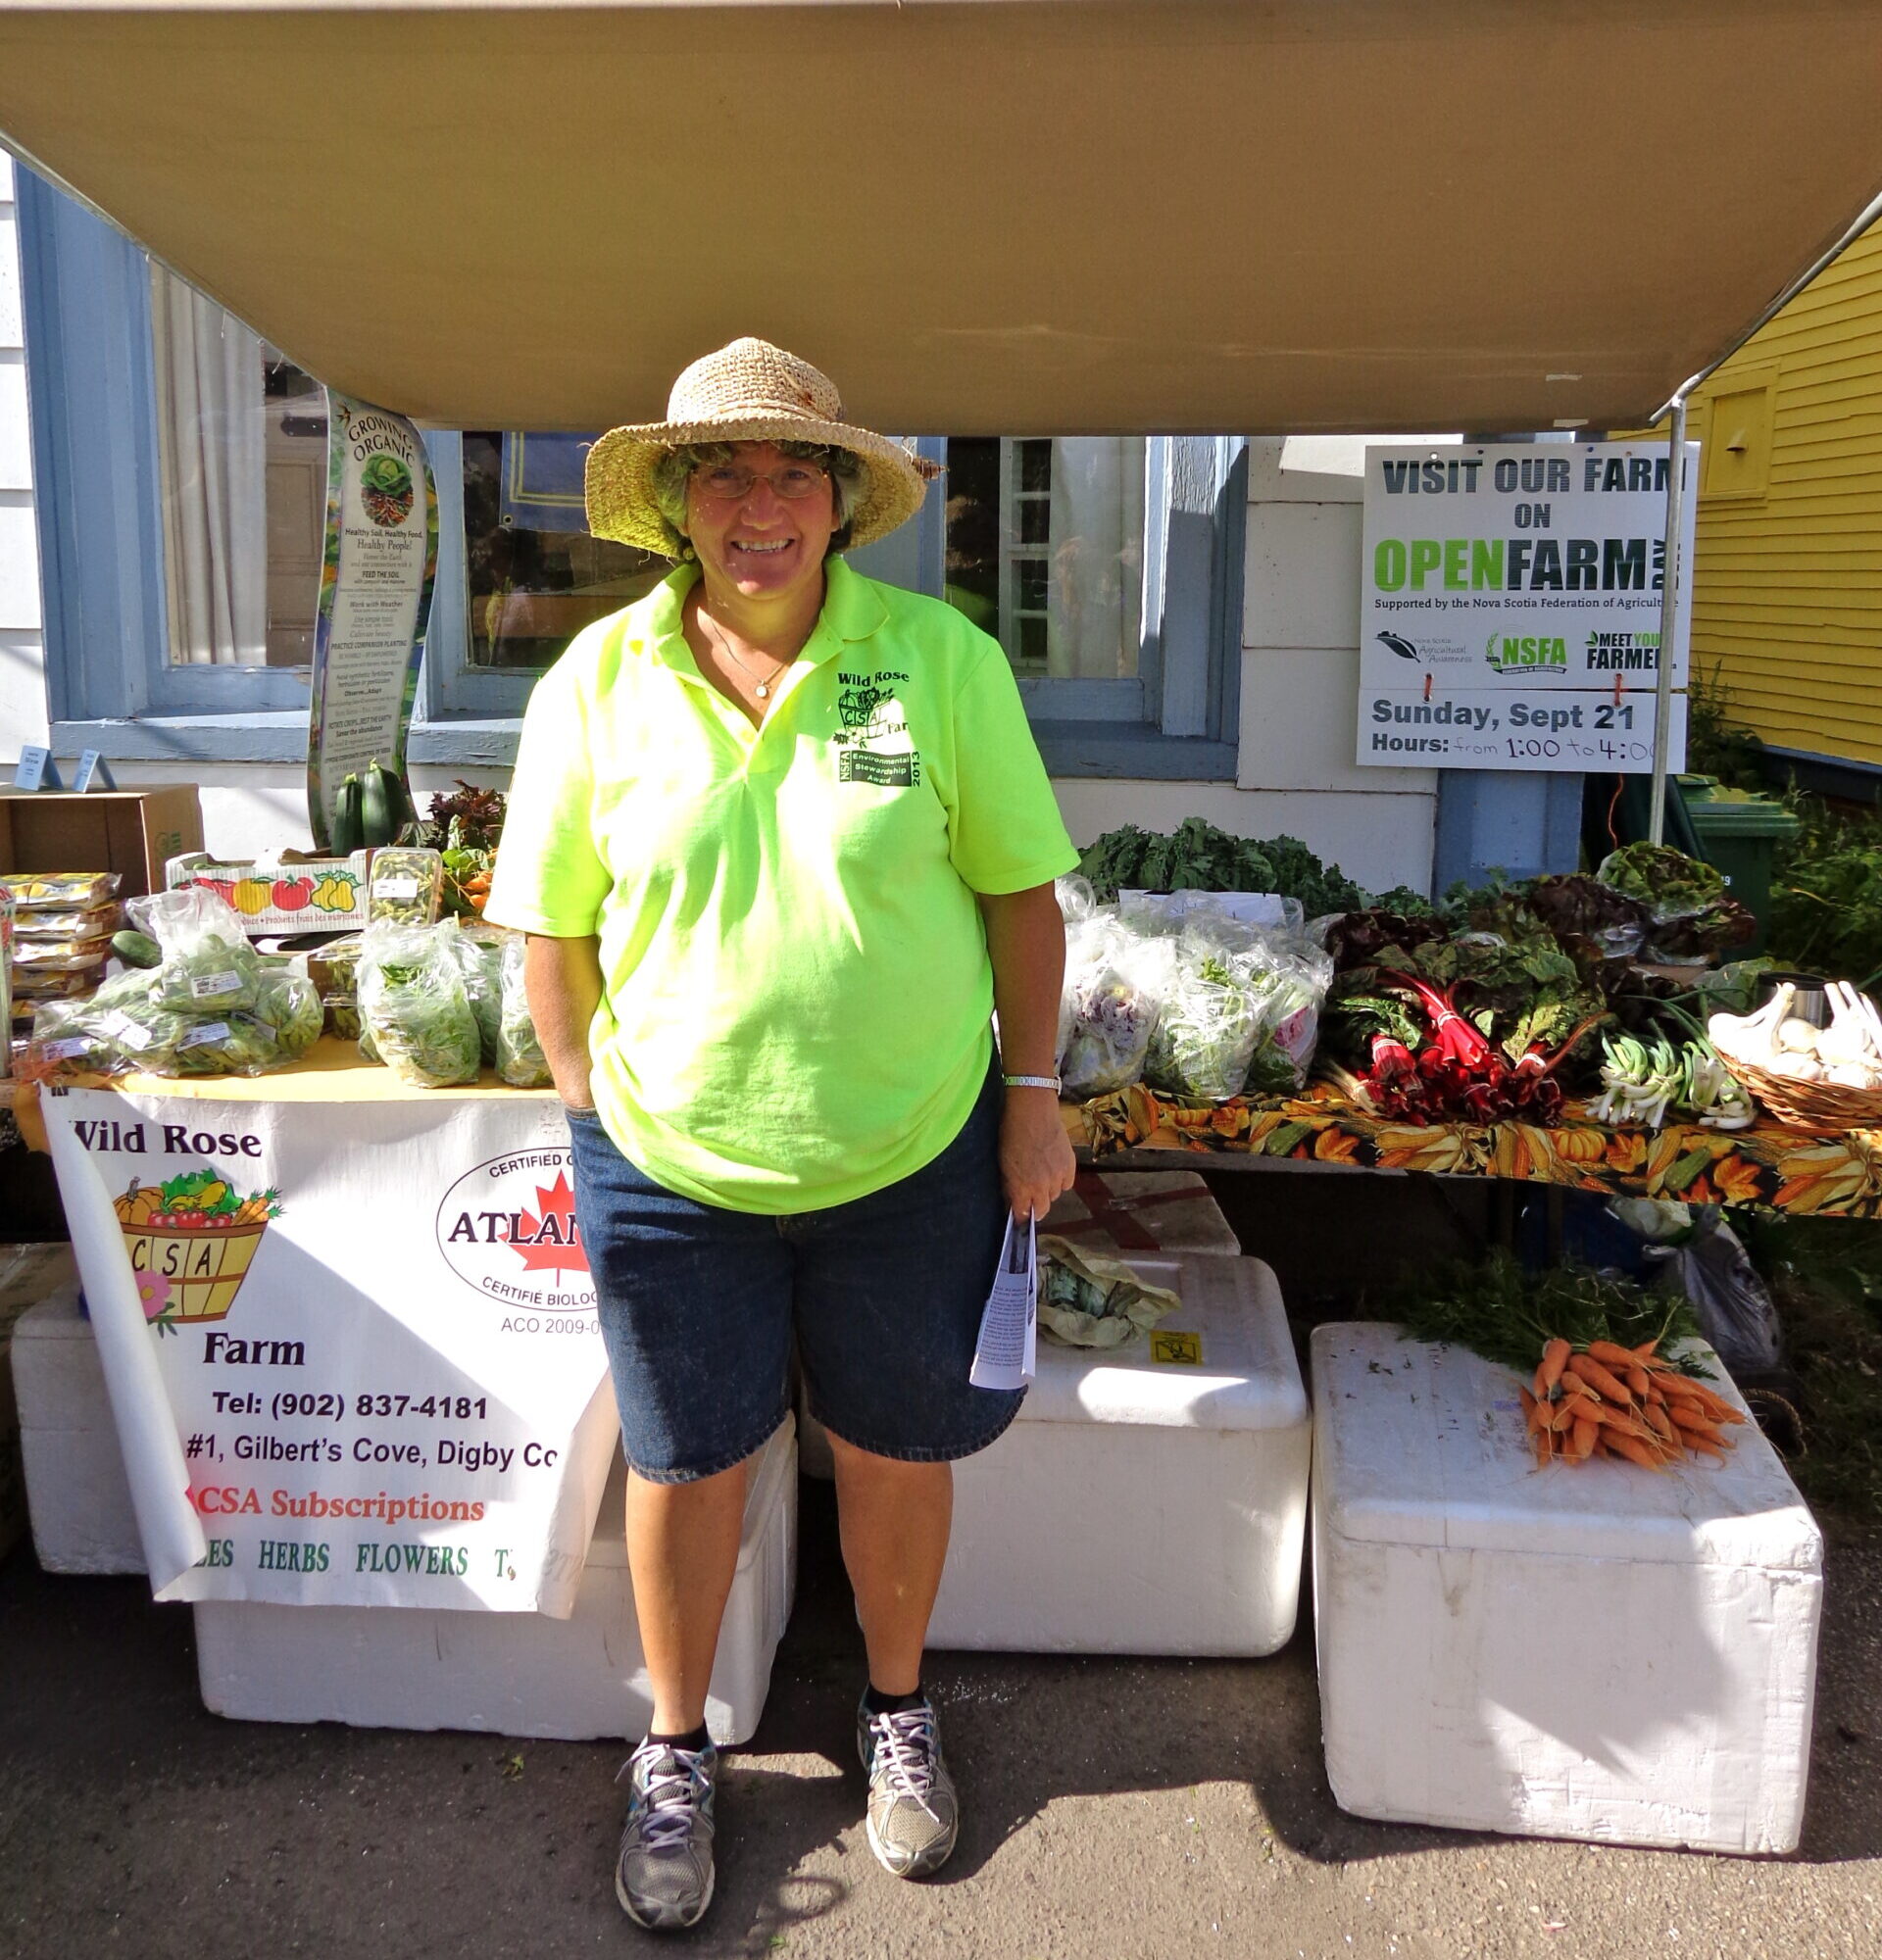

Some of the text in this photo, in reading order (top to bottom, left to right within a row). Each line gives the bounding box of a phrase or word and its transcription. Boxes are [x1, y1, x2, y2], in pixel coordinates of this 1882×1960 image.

[349, 416, 413, 450] GROWING
[353, 434, 415, 468] ORGANIC
[1382, 459, 1483, 494] VISIT
[1494, 458, 1570, 493] OUR
[1514, 503, 1551, 528] ON
[345, 528, 370, 537] Healthy
[385, 529, 407, 539] Healthy
[357, 539, 412, 553] Healthy People!
[1374, 597, 1678, 611] Supported by the Nova Scotia Federation of Agriculte
[1502, 637, 1566, 665] NSFA
[1599, 633, 1661, 647] MEET YOU
[837, 671, 910, 687] Wild Rose
[845, 710, 878, 725] CSA
[887, 721, 910, 734] Far
[1372, 699, 1634, 733] Sunday, Sept 21
[853, 753, 910, 765] Environmental
[1372, 732, 1449, 753] Hours:
[1453, 735, 1499, 755] from
[1508, 737, 1560, 759] 1:00
[1567, 736, 1595, 757] to
[840, 752, 850, 781] NSFA
[855, 762, 907, 775] Stewardship
[867, 774, 892, 784] Award
[912, 751, 920, 787] 2013
[163, 1124, 262, 1157] Rose
[489, 1153, 563, 1178] CERTIFIED
[501, 1317, 540, 1334] ACO
[202, 1331, 306, 1367] Farm
[212, 1391, 487, 1422] Tel: (902) 837-4181
[186, 1434, 224, 1463] #1,
[233, 1435, 343, 1462] Gilbert's
[352, 1437, 428, 1469] Cove,
[437, 1440, 515, 1474] Digby
[198, 1487, 485, 1525] CSA Subscriptions
[258, 1539, 330, 1573] HERBS
[355, 1543, 469, 1577] FLOWERS
